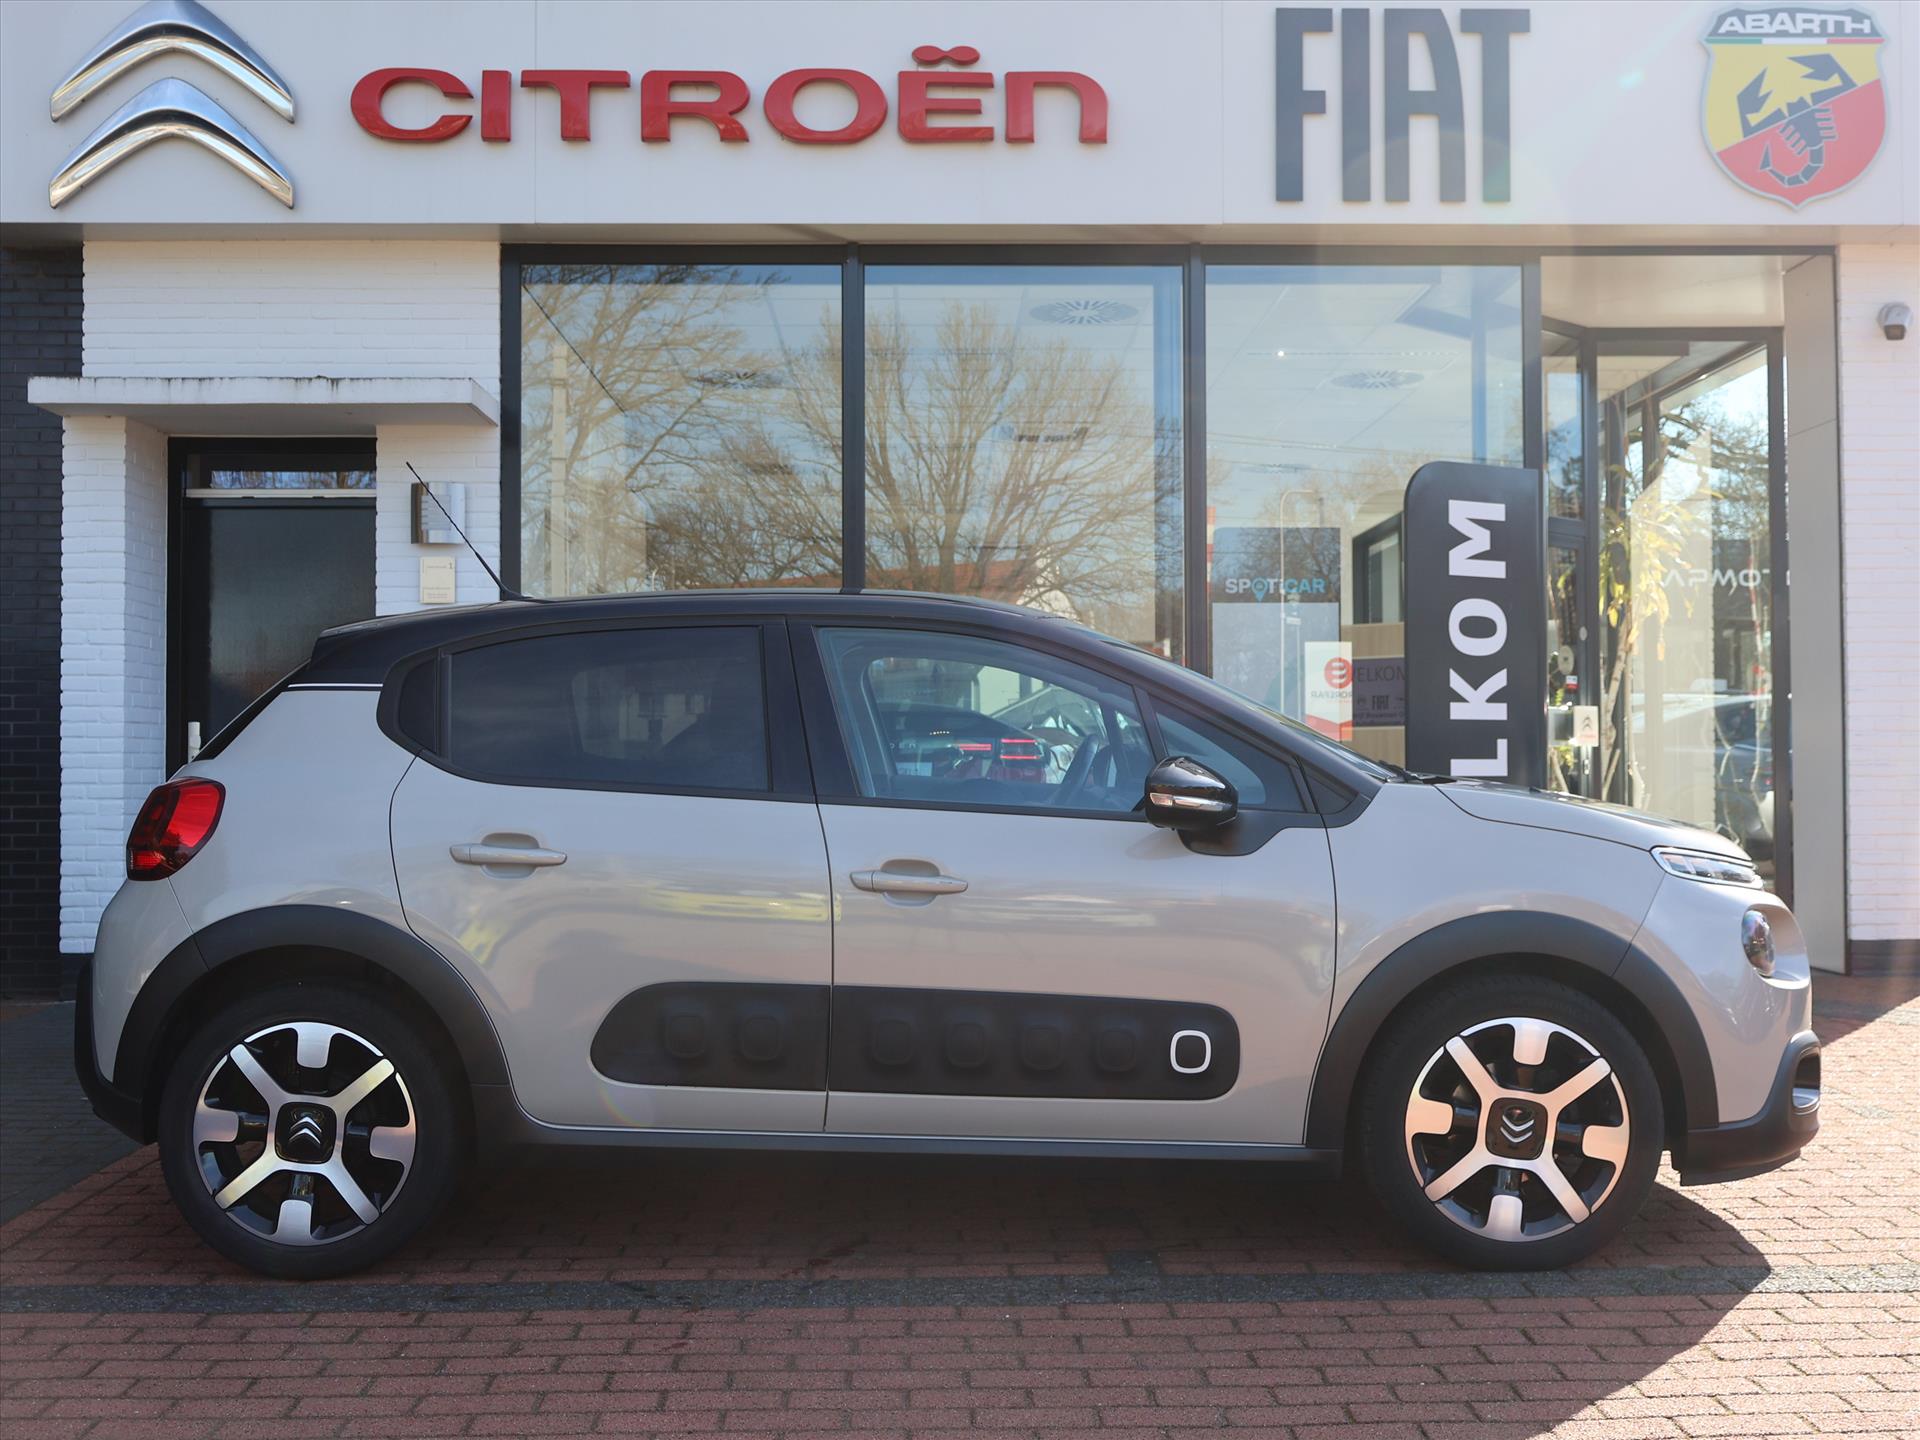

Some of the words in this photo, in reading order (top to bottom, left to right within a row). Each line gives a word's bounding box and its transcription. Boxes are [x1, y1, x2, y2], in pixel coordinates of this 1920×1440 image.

[1717, 12, 1872, 34] ABARTH
[350, 45, 1109, 144] CITROËN
[1276, 8, 1530, 201] FIAT
